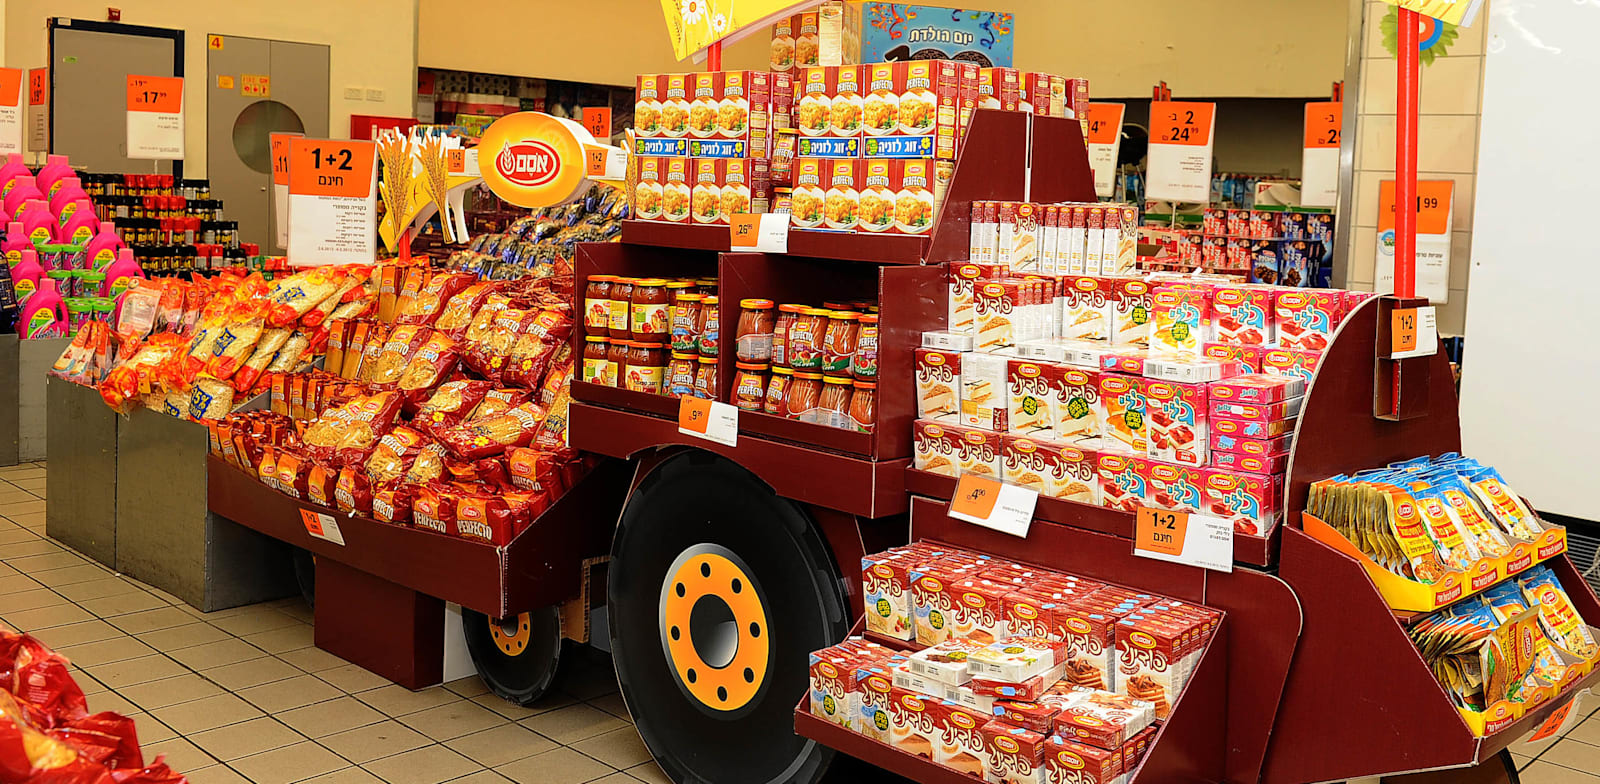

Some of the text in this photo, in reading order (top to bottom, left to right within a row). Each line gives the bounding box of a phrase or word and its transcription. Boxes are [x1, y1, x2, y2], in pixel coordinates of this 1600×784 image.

[211, 37, 221, 48] 4
[908, 26, 974, 45] יום הולדת
[806, 82, 826, 93] PERFECTO
[837, 82, 858, 93] PERFECTO
[871, 80, 893, 91] PERFECTO
[906, 78, 930, 90] PERFECTO
[142, 92, 158, 103] 17
[1185, 111, 1194, 125] 2
[1171, 127, 1190, 141] 24
[1327, 129, 1341, 144] 2
[312, 148, 353, 171] 1+2
[318, 175, 344, 186] חינם
[798, 174, 819, 185] PERFECTO
[832, 175, 854, 186] PERFECTO
[866, 176, 889, 187] PERFECTO
[902, 176, 927, 187] PERFECTO
[1424, 198, 1438, 209] 99
[738, 225, 748, 235] 26
[976, 293, 1013, 315] פודינג
[1068, 287, 1106, 309] פודינג
[1231, 301, 1264, 330] ג'לי
[1294, 305, 1328, 335] ג'לי
[1401, 315, 1413, 330] 1+2
[918, 361, 953, 383] פודינג
[737, 385, 763, 397] PERFECTO
[1011, 373, 1049, 395] פודינג
[1162, 397, 1194, 426] ג'לי
[918, 432, 952, 454] פודינג
[959, 440, 994, 462] פודינג
[1006, 446, 1045, 470] פודינג
[1052, 456, 1092, 480] פודינג
[971, 489, 978, 500] 4
[1115, 470, 1145, 499] ג'לי
[1168, 479, 1200, 510] ג'לי
[1225, 489, 1258, 520] ג'לי
[414, 511, 446, 533] PERFECTO
[457, 520, 493, 541] PERFECTO
[1152, 512, 1176, 530] 1+2
[1153, 532, 1172, 544] חינם
[867, 572, 902, 597] פודינג
[914, 584, 951, 611] פודינג
[955, 600, 995, 628] פודינג
[1058, 625, 1102, 656] פודינג
[1120, 640, 1168, 672] פודינג
[814, 668, 845, 699] פודינג
[893, 702, 934, 734] פודינג
[942, 719, 984, 752] פודינג
[989, 743, 1031, 775] פודינג
